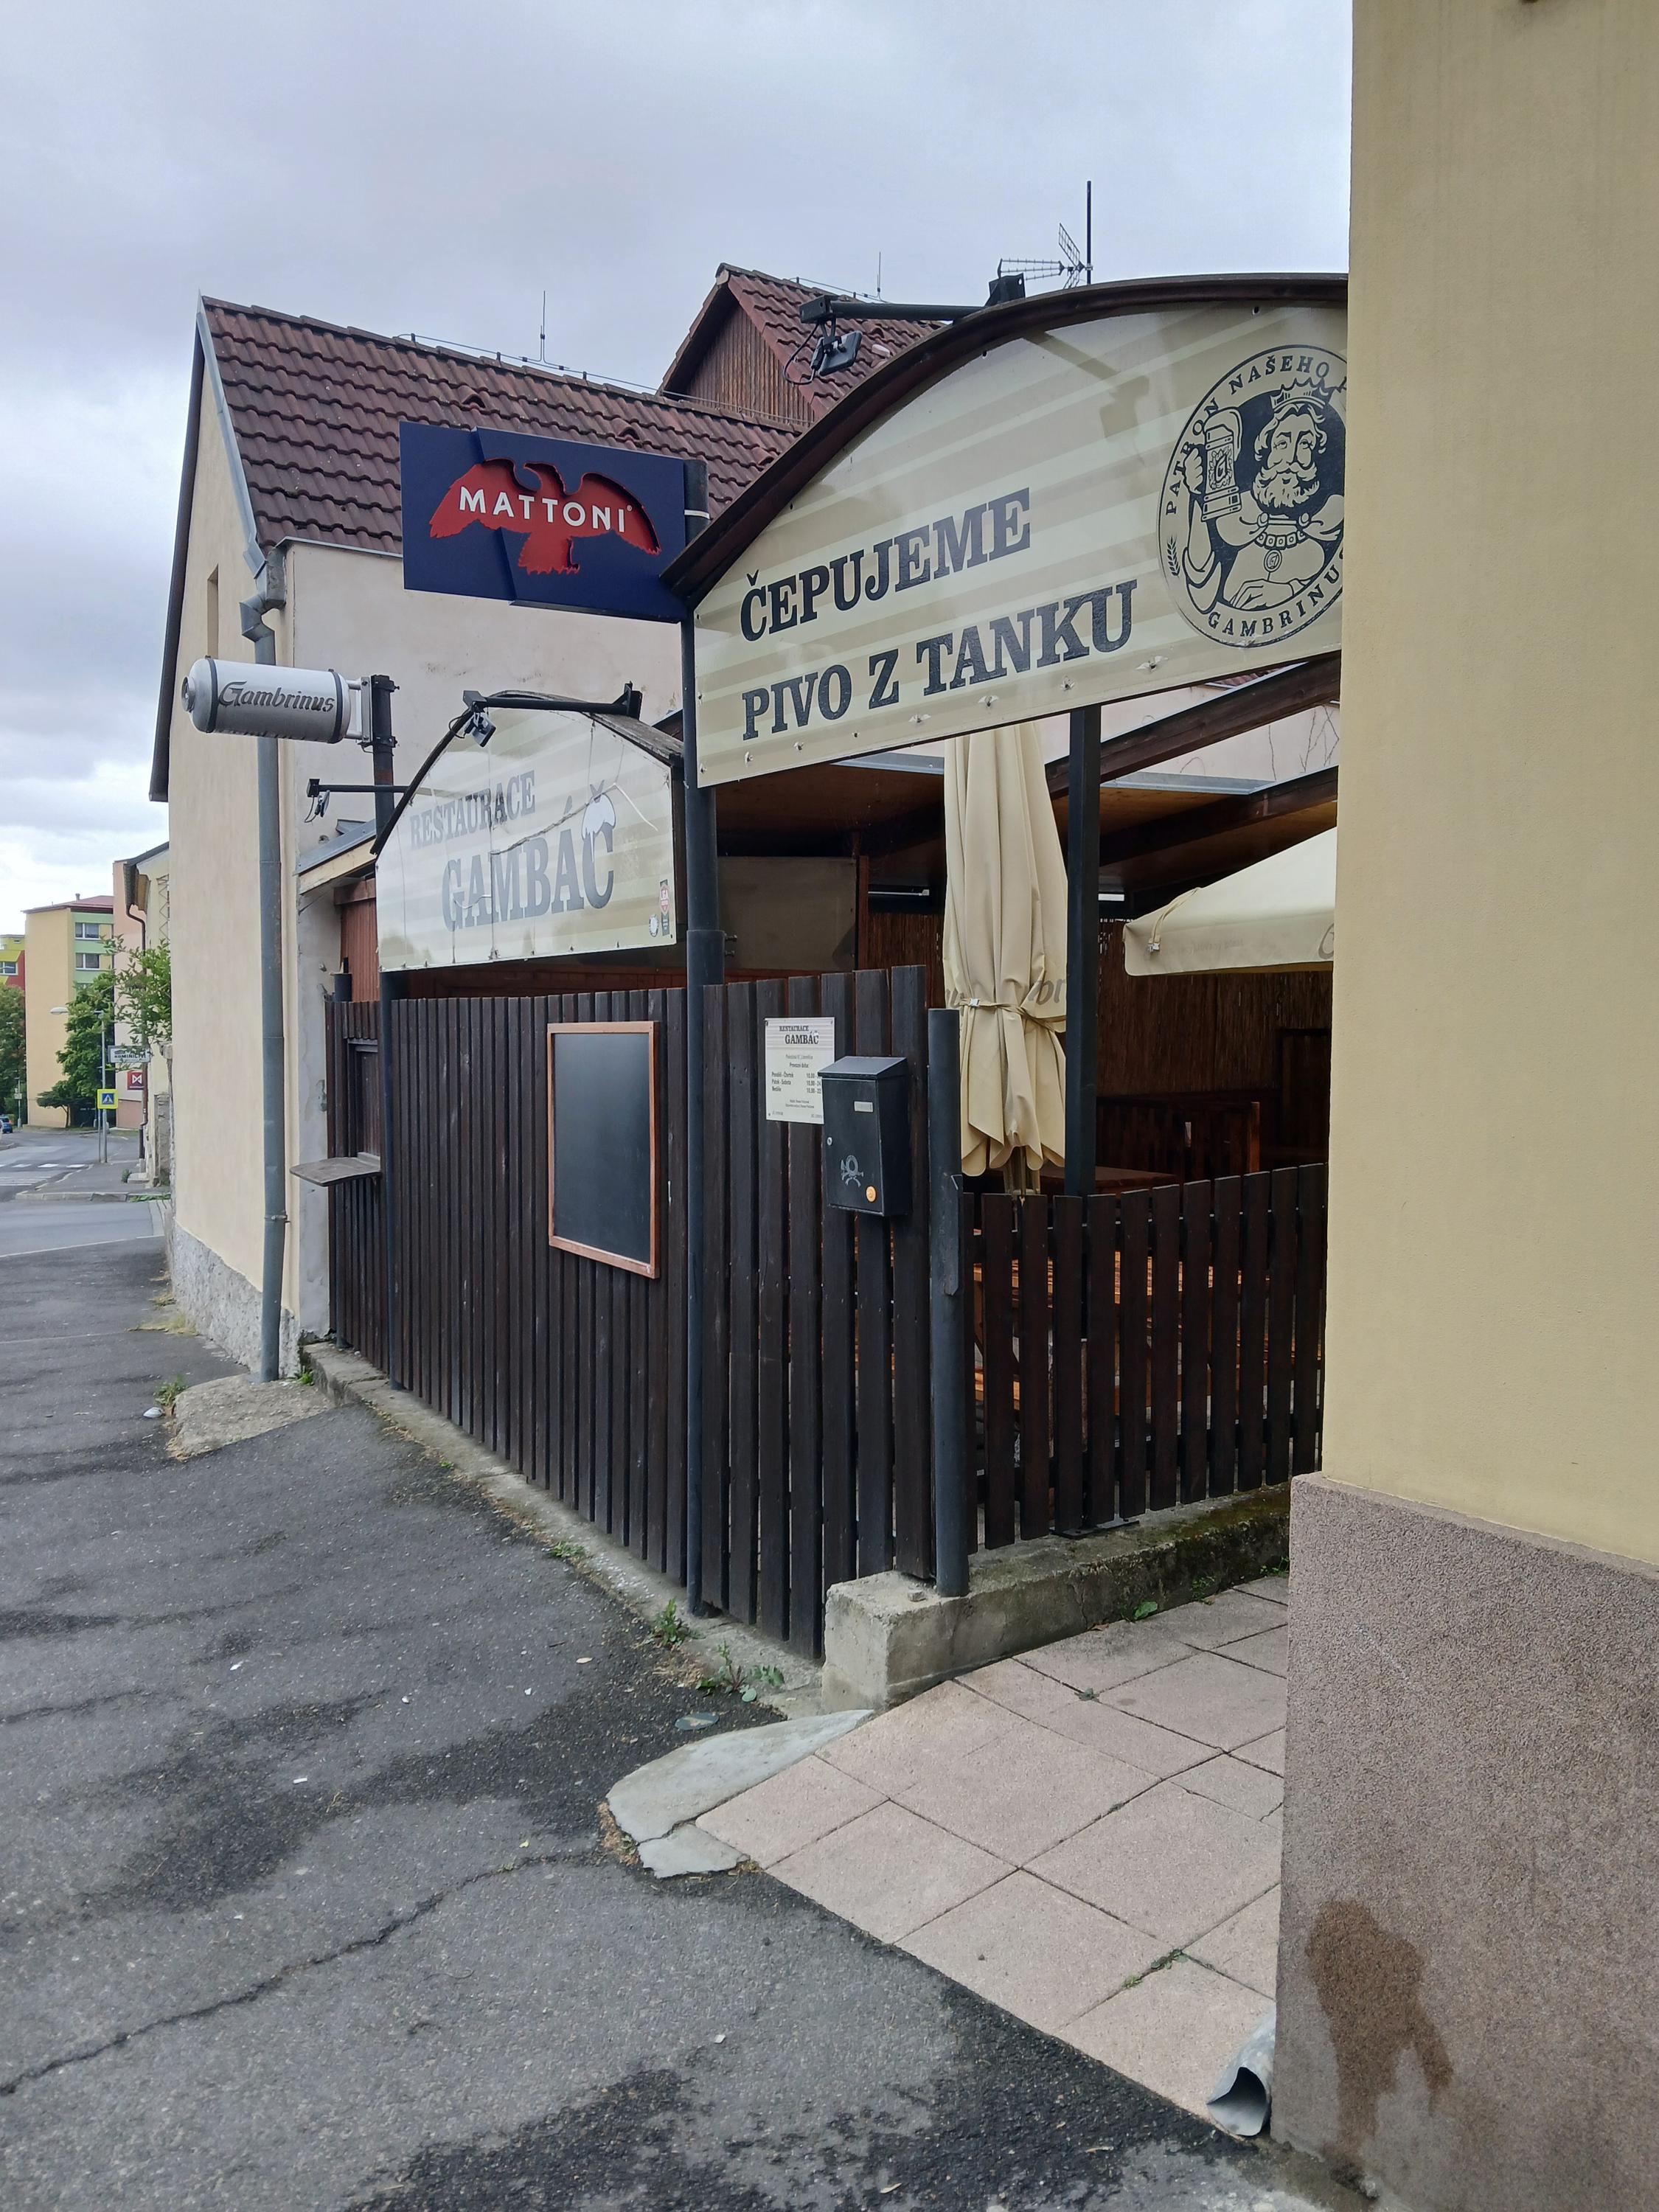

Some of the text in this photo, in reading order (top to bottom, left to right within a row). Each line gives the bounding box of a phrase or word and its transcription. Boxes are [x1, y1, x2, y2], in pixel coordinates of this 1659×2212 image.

[1166, 355, 1330, 515] PATRON NAŠEHO
[459, 486, 625, 532] MATTONI
[740, 487, 1031, 641] ČEPUJEME
[1208, 552, 1343, 637] GAMBRINU
[218, 681, 335, 712] Gambrinus
[742, 580, 1138, 740] PIVO Z TANKU
[410, 770, 535, 849] RESTAURACE
[442, 779, 616, 932] GAMBÁČ
